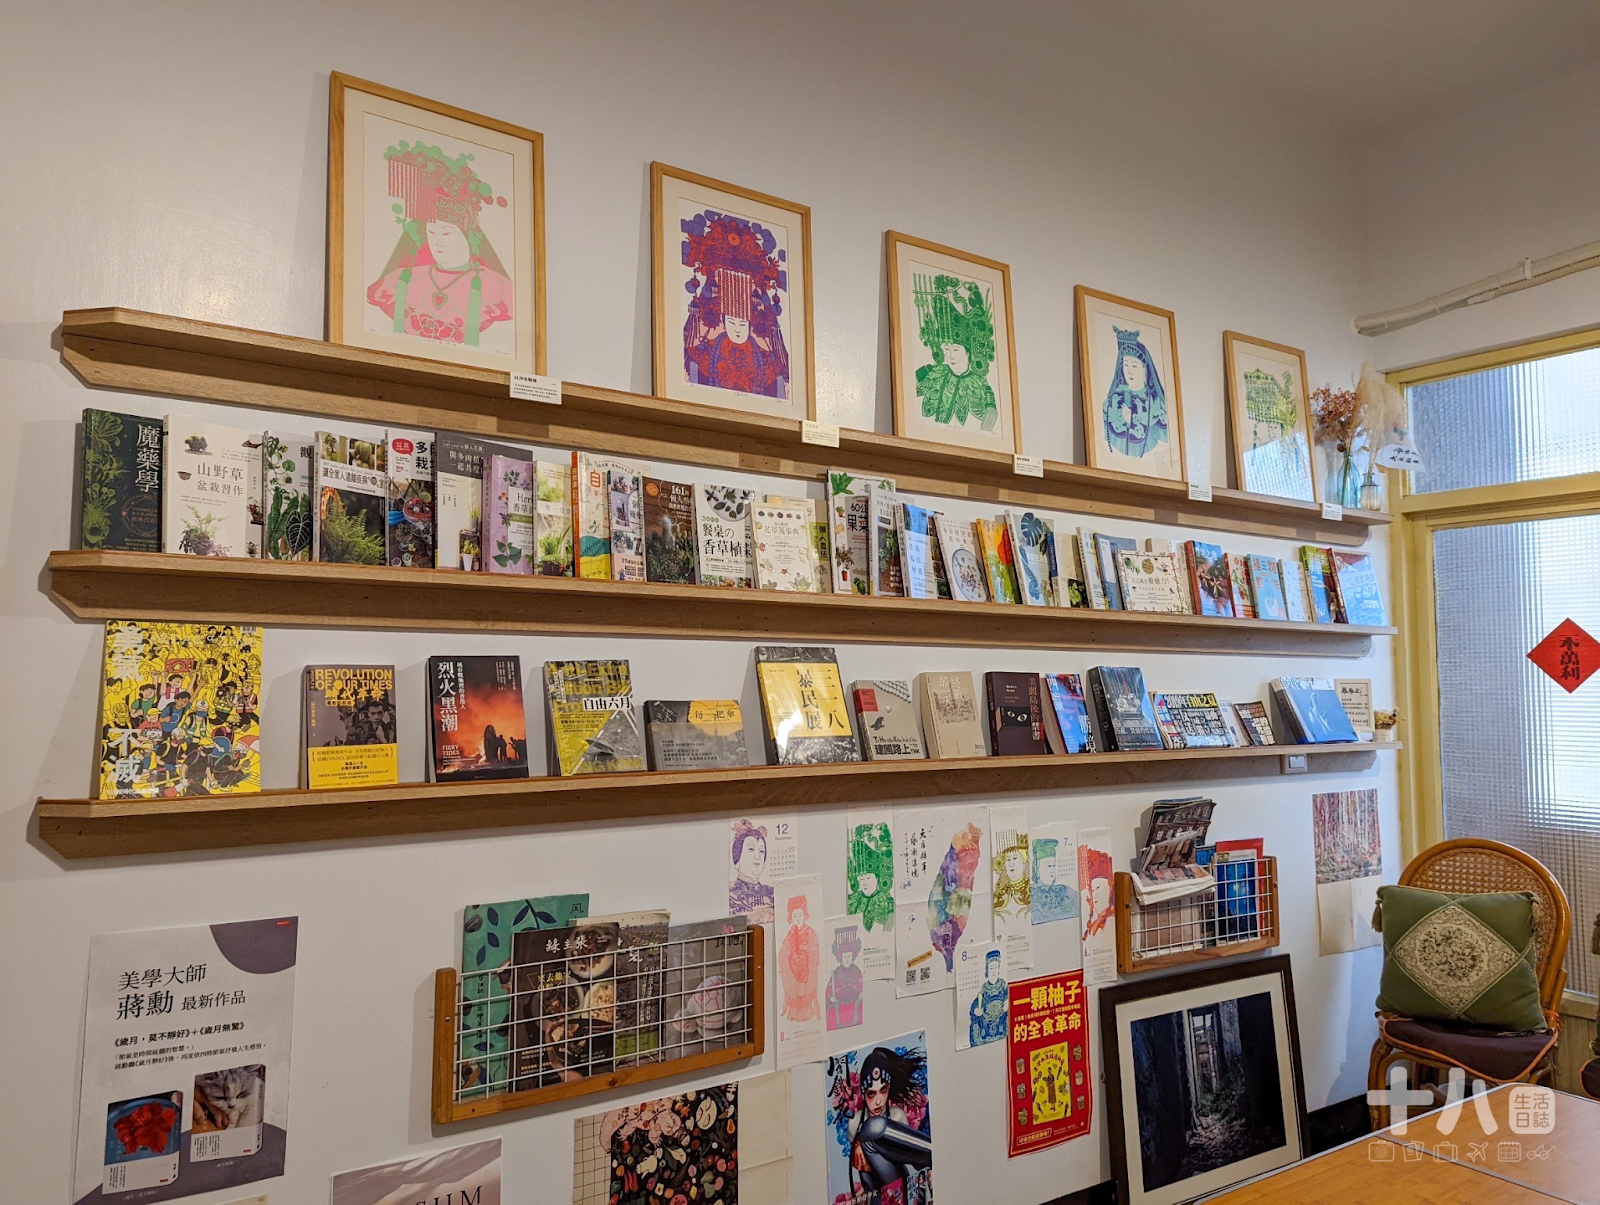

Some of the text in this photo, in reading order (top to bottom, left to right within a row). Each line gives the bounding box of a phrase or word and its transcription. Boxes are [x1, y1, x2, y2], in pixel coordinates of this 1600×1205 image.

[135, 424, 161, 493] 魔藥學
[197, 462, 243, 481] 山野草
[197, 480, 243, 496] 盆栽習作
[315, 668, 393, 680] REVOLUTION
[315, 680, 332, 690] OF
[360, 680, 393, 690] TIMES
[437, 661, 459, 732] 烈火黑潮
[583, 696, 631, 710] 自由六月
[796, 668, 824, 731] 暴民展
[776, 823, 788, 835] 12
[961, 950, 968, 962] 8
[117, 963, 207, 991] 美學大師
[115, 989, 246, 1021] 蔣勳 最新作品
[1012, 980, 1082, 1011] 一顆柚子
[1013, 1011, 1082, 1043] 的全食革命
